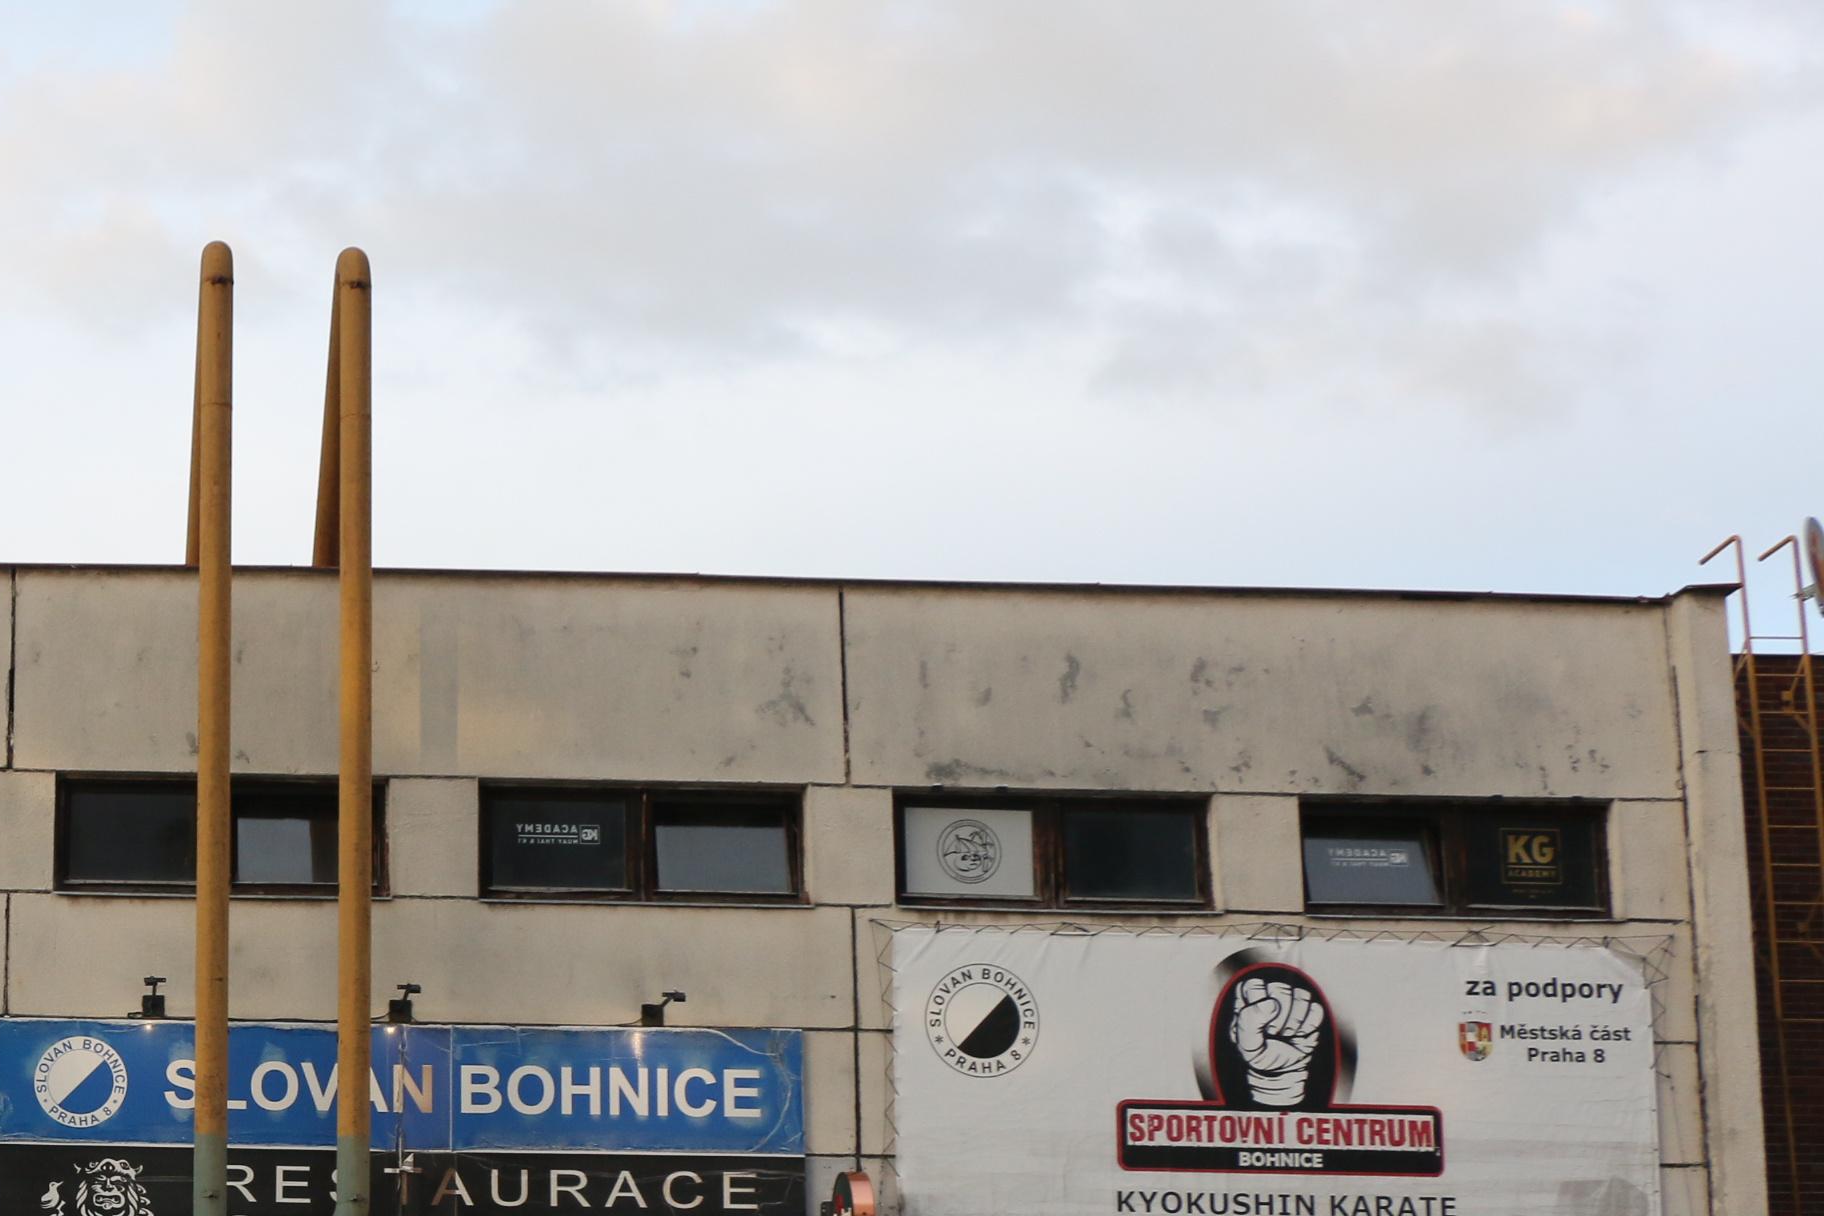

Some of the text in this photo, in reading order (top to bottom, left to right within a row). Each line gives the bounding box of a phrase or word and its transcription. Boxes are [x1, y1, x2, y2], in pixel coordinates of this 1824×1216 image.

[1508, 835, 1554, 864] KG
[930, 968, 1036, 1029] SLOVAN BOHNICE
[1466, 977, 1623, 1004] za podpory
[1500, 1024, 1632, 1041] Městská část
[37, 1039, 126, 1094] SLOVAN BOHNICE
[944, 1048, 1021, 1073] PRAHA 8
[1528, 1048, 1606, 1063] Praha 8
[164, 1059, 761, 1117] SOVN BOHNICE
[49, 1105, 112, 1126] PRAHA 8
[1128, 1111, 1434, 1148] SPORTOVNÍ CENTRUM
[1238, 1151, 1324, 1168] BOHNICE
[226, 1165, 759, 1209] RETAURACE
[1116, 1190, 1316, 1216] KYOKUSHIN
